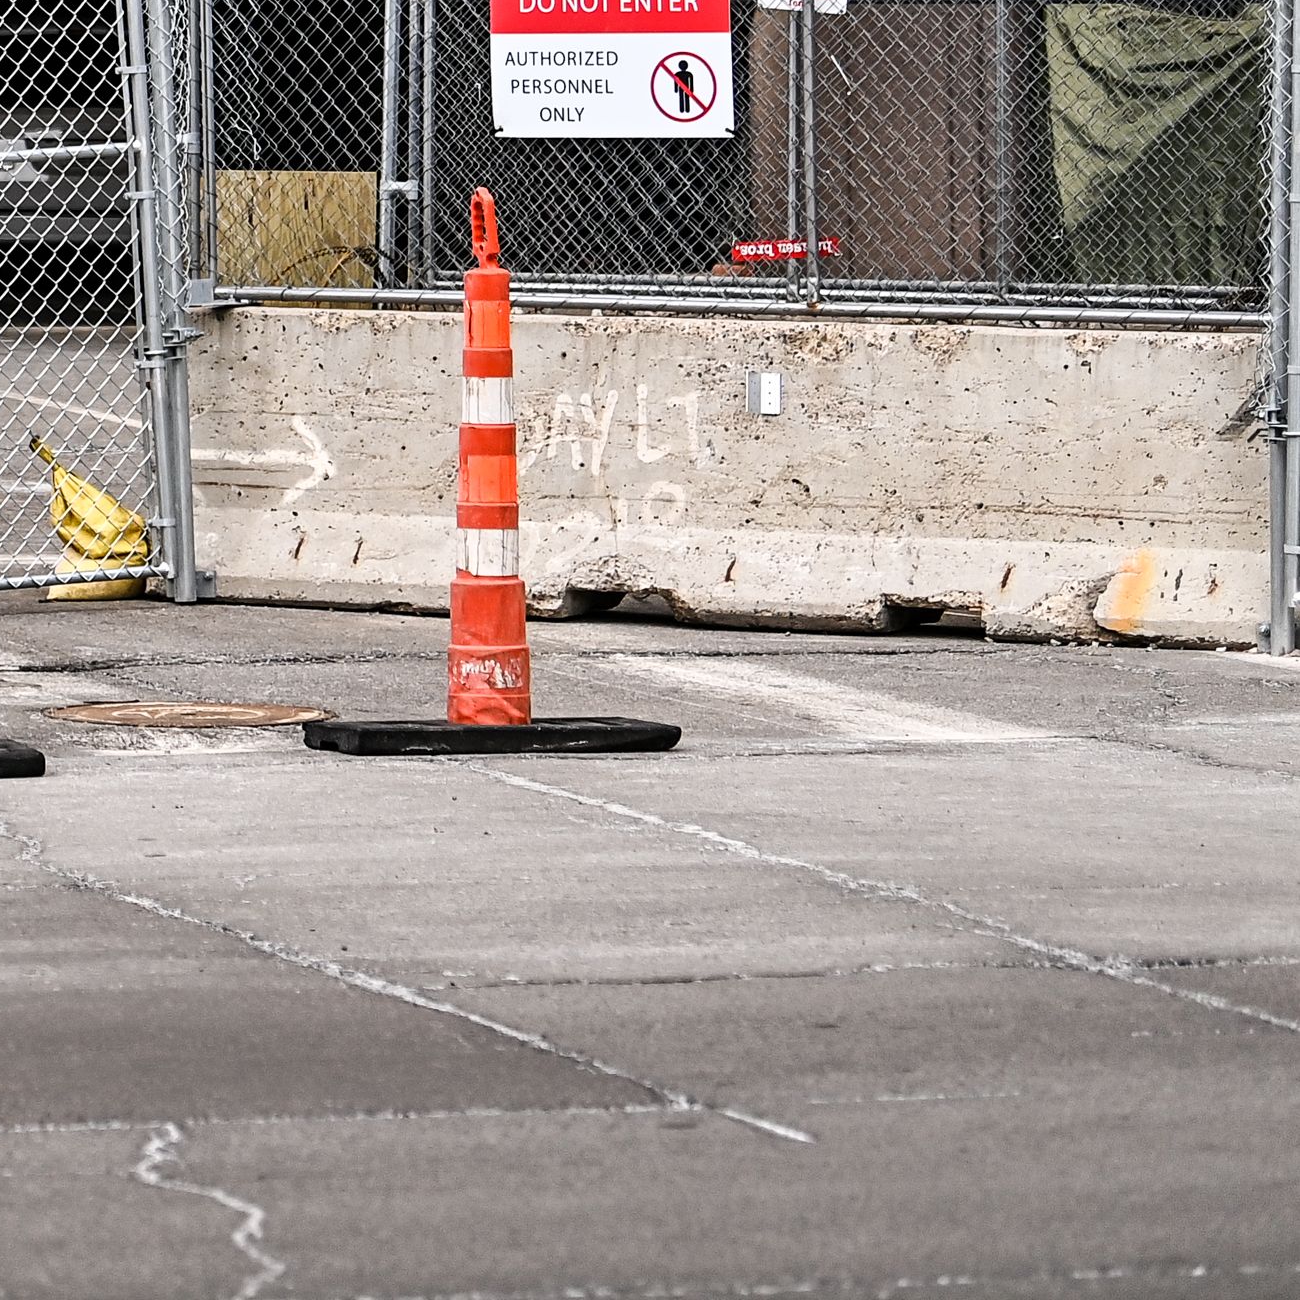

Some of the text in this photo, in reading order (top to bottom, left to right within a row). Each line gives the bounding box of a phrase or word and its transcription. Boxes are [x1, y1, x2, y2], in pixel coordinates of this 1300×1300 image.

[504, 51, 619, 67] AUTHORIZED
[510, 79, 615, 95] PERSONNEL
[539, 106, 585, 123] ONLY
